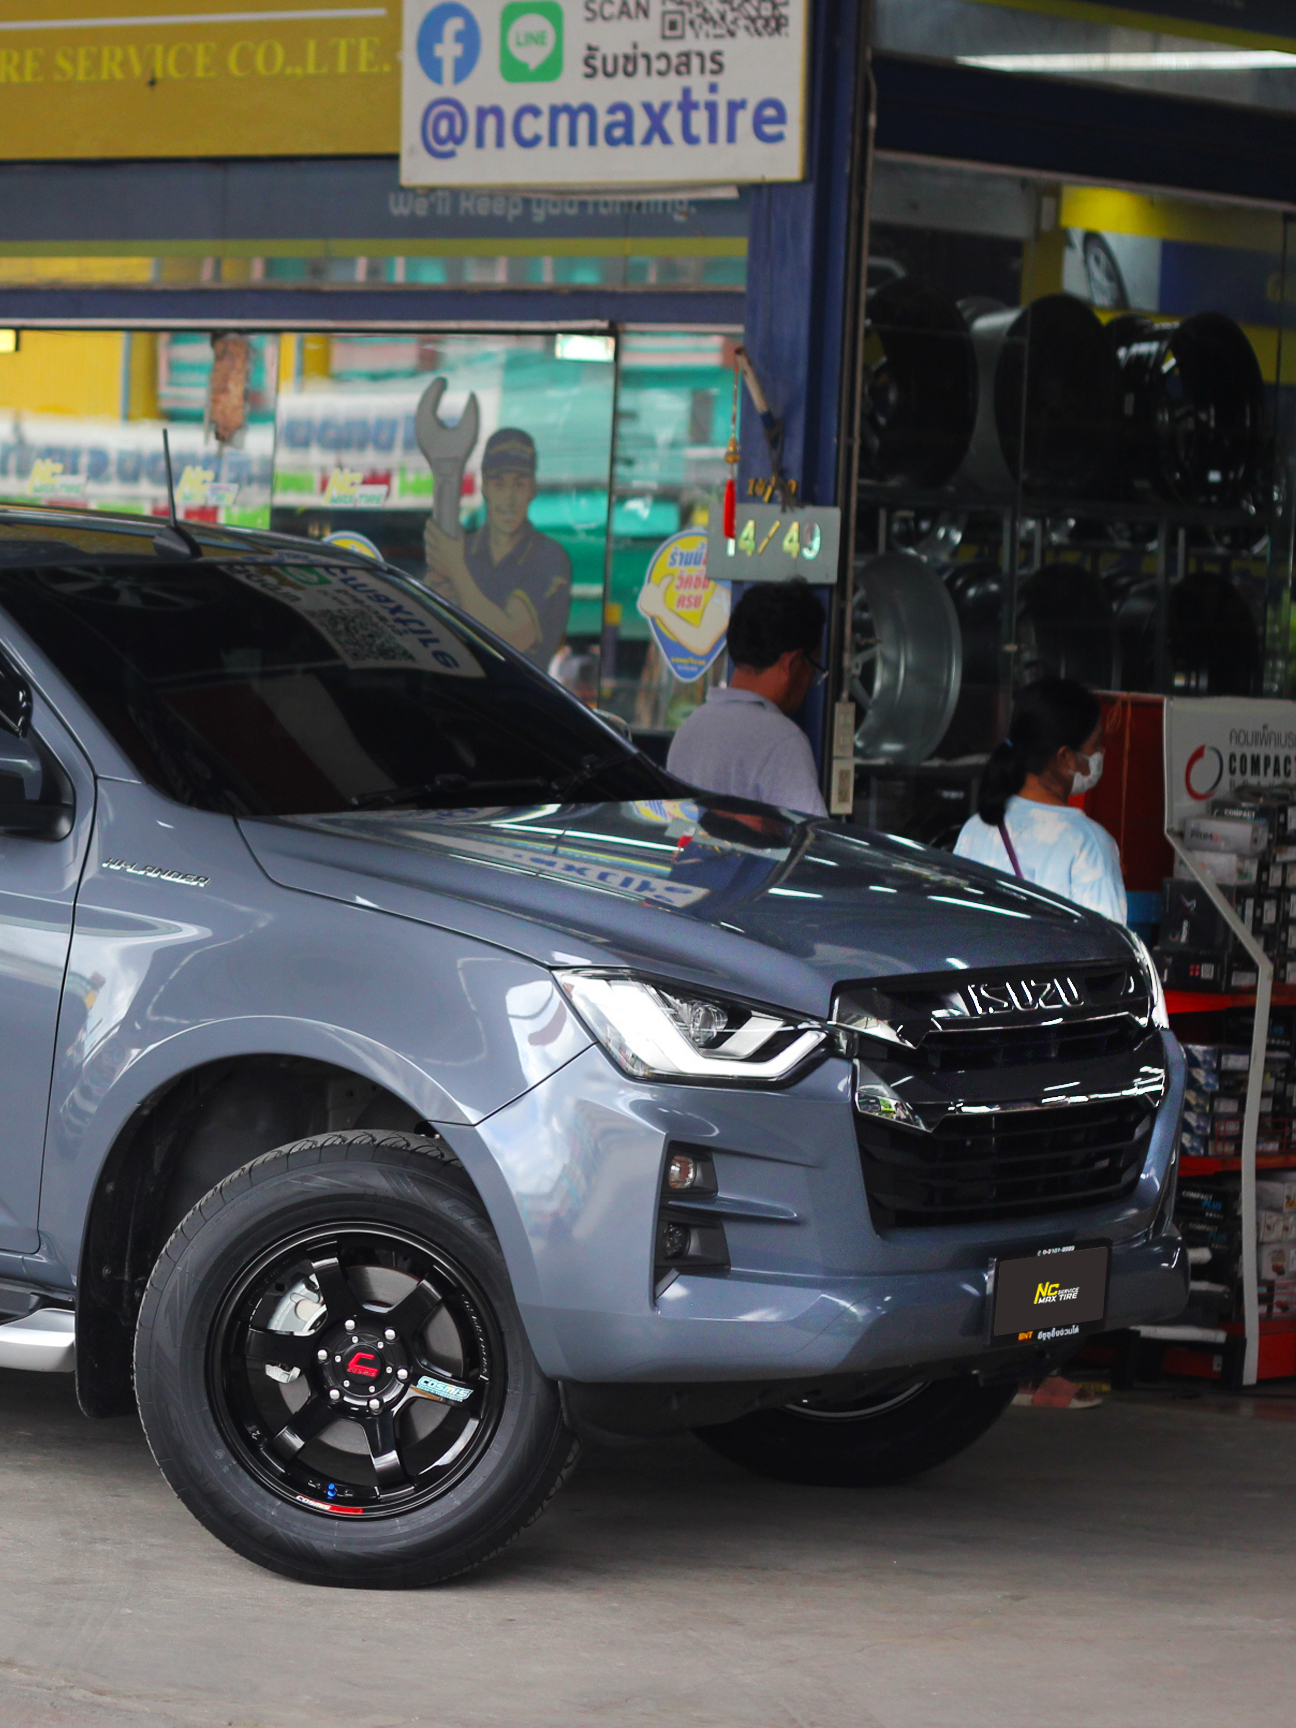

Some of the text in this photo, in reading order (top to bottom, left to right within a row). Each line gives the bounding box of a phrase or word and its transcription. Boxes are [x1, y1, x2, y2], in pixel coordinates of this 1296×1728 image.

[584, 0, 650, 21] SCAN
[516, 31, 547, 47] LINE
[54, 42, 217, 82] SERVICE
[583, 42, 725, 79] รับข่าวสาร
[421, 82, 788, 159] @ncmaxtire
[1229, 753, 1296, 778] COMPAC
[968, 977, 1084, 1015] ISUZU
[1034, 1281, 1080, 1304] NC SERVICE
[1037, 1292, 1079, 1304] MAX TIRE
[418, 1377, 472, 1399] COSMIS
